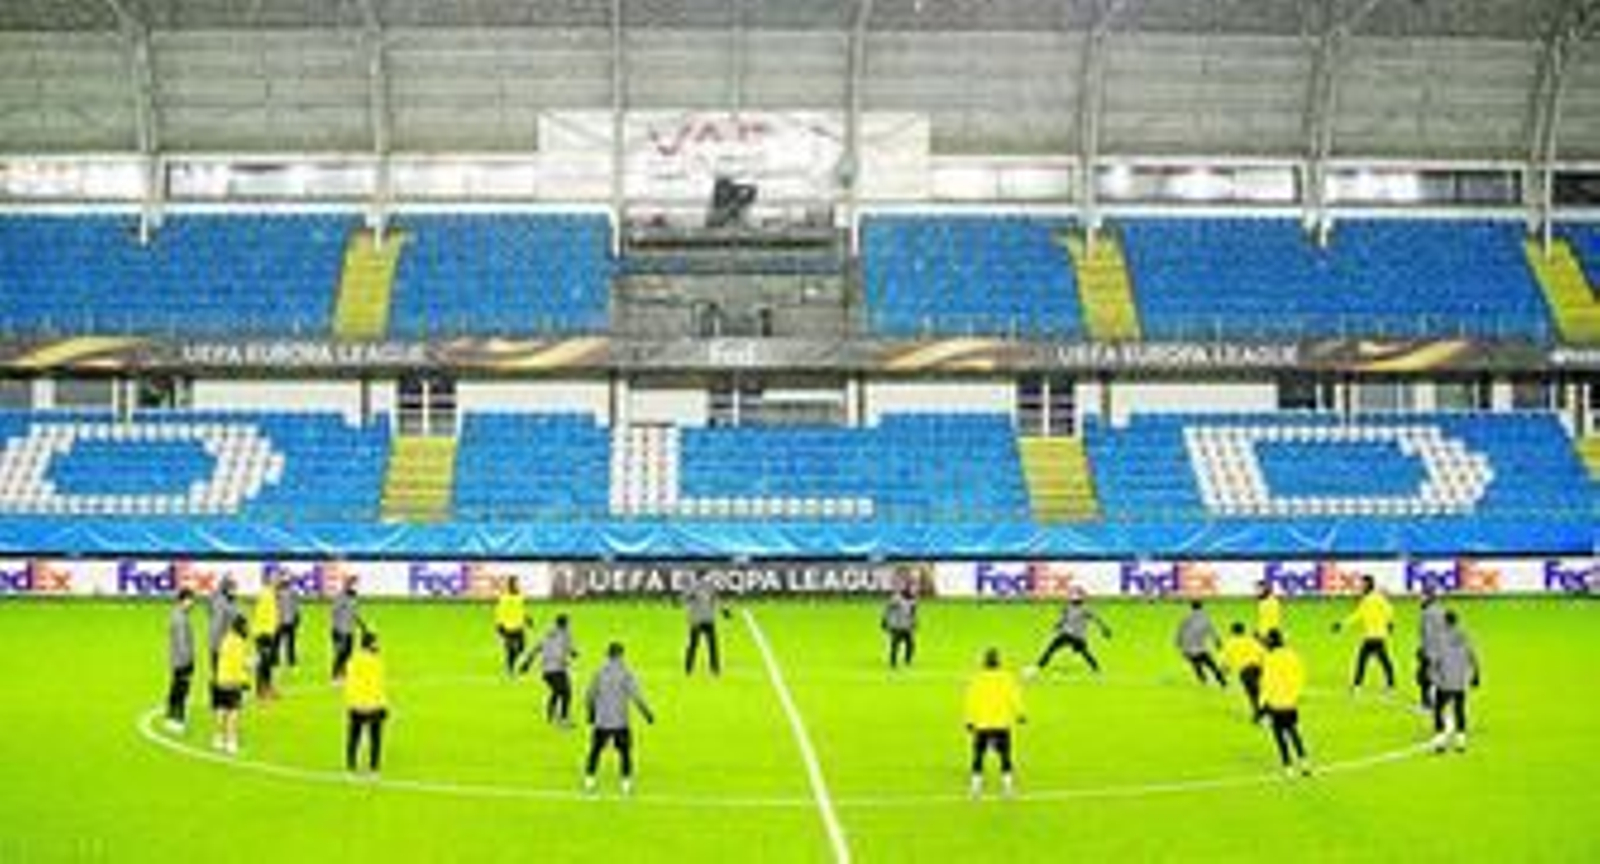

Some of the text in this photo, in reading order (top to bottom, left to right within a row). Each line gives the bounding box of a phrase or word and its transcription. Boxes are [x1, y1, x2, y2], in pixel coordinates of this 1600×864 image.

[116, 561, 214, 593] FedEx
[408, 562, 508, 595] FedEx
[589, 568, 665, 592] UEFA
[976, 561, 1073, 595] FedEx
[1120, 561, 1217, 595] FedEx
[1263, 561, 1363, 594] FedEx
[1405, 560, 1500, 592] FedEx
